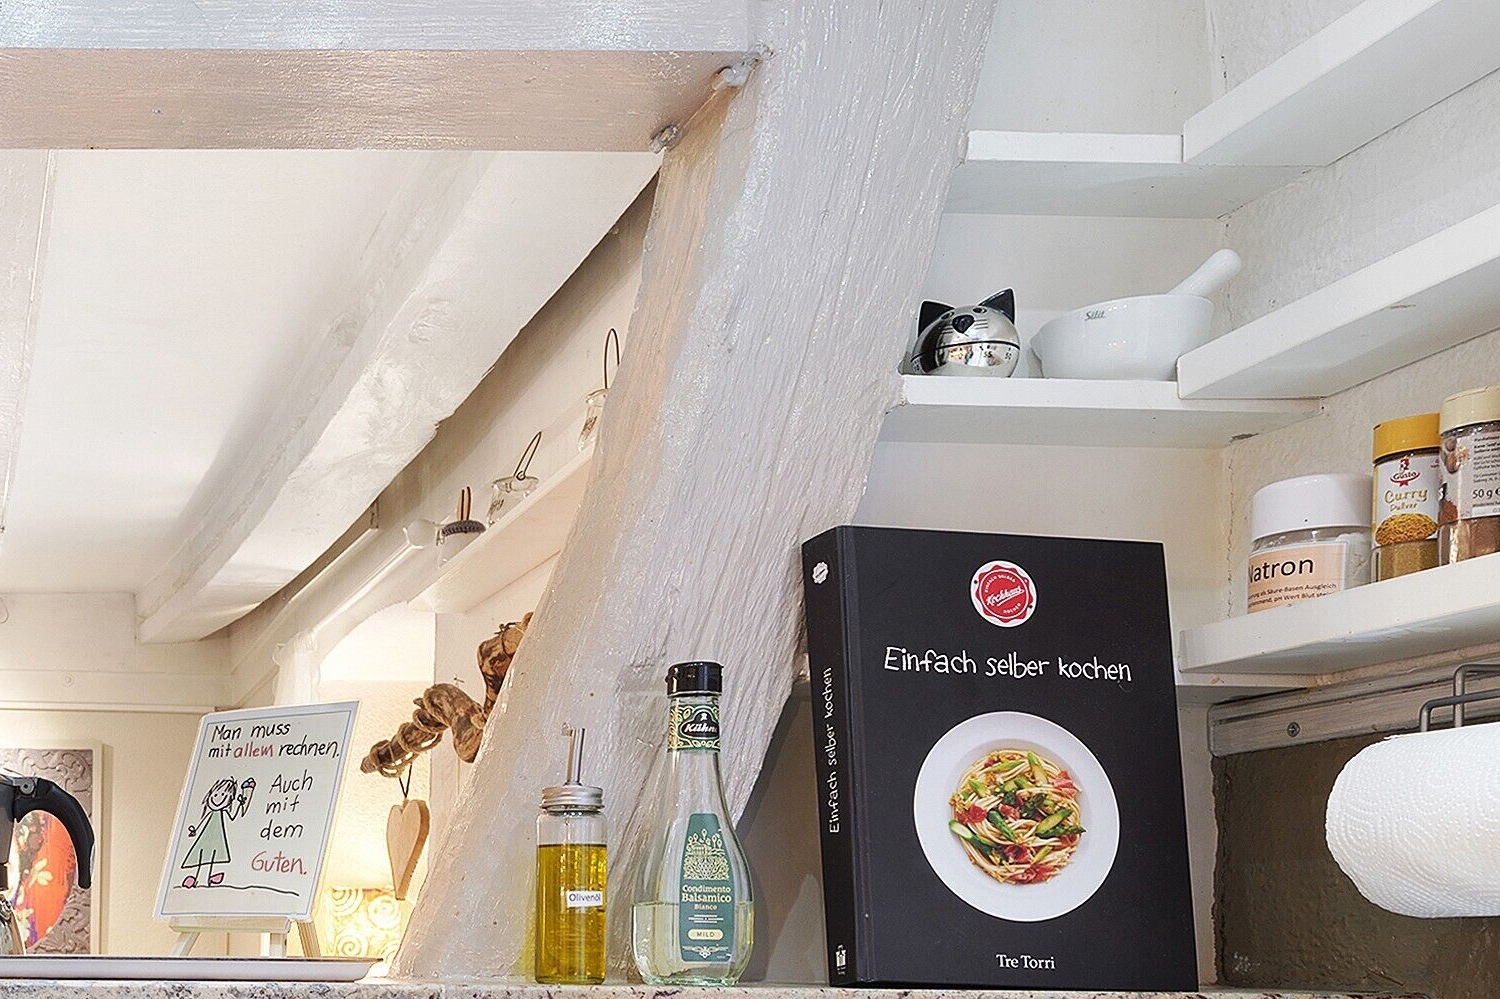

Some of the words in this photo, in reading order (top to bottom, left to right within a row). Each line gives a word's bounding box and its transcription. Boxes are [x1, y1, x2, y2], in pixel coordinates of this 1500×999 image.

[1385, 490, 1428, 503] Curry
[1473, 489, 1484, 499] 50
[884, 646, 977, 676] Einfach
[985, 656, 1050, 679] selber
[1058, 656, 1132, 683] kochen
[822, 667, 834, 718] kochen
[211, 724, 242, 743] Man
[250, 723, 291, 738] muss
[208, 745, 232, 758] mit
[278, 734, 340, 758] rechnen.
[825, 723, 838, 766] selber
[269, 769, 313, 794] Auch
[265, 795, 300, 815] mit
[829, 772, 841, 834] Einfach
[260, 819, 304, 840] dem
[251, 850, 307, 875] Guten.
[569, 893, 601, 902] Olivenöl
[682, 884, 731, 893] Condimento
[682, 893, 732, 903] Balsamico
[996, 954, 1020, 969] Tre
[1021, 955, 1056, 970] Torri
